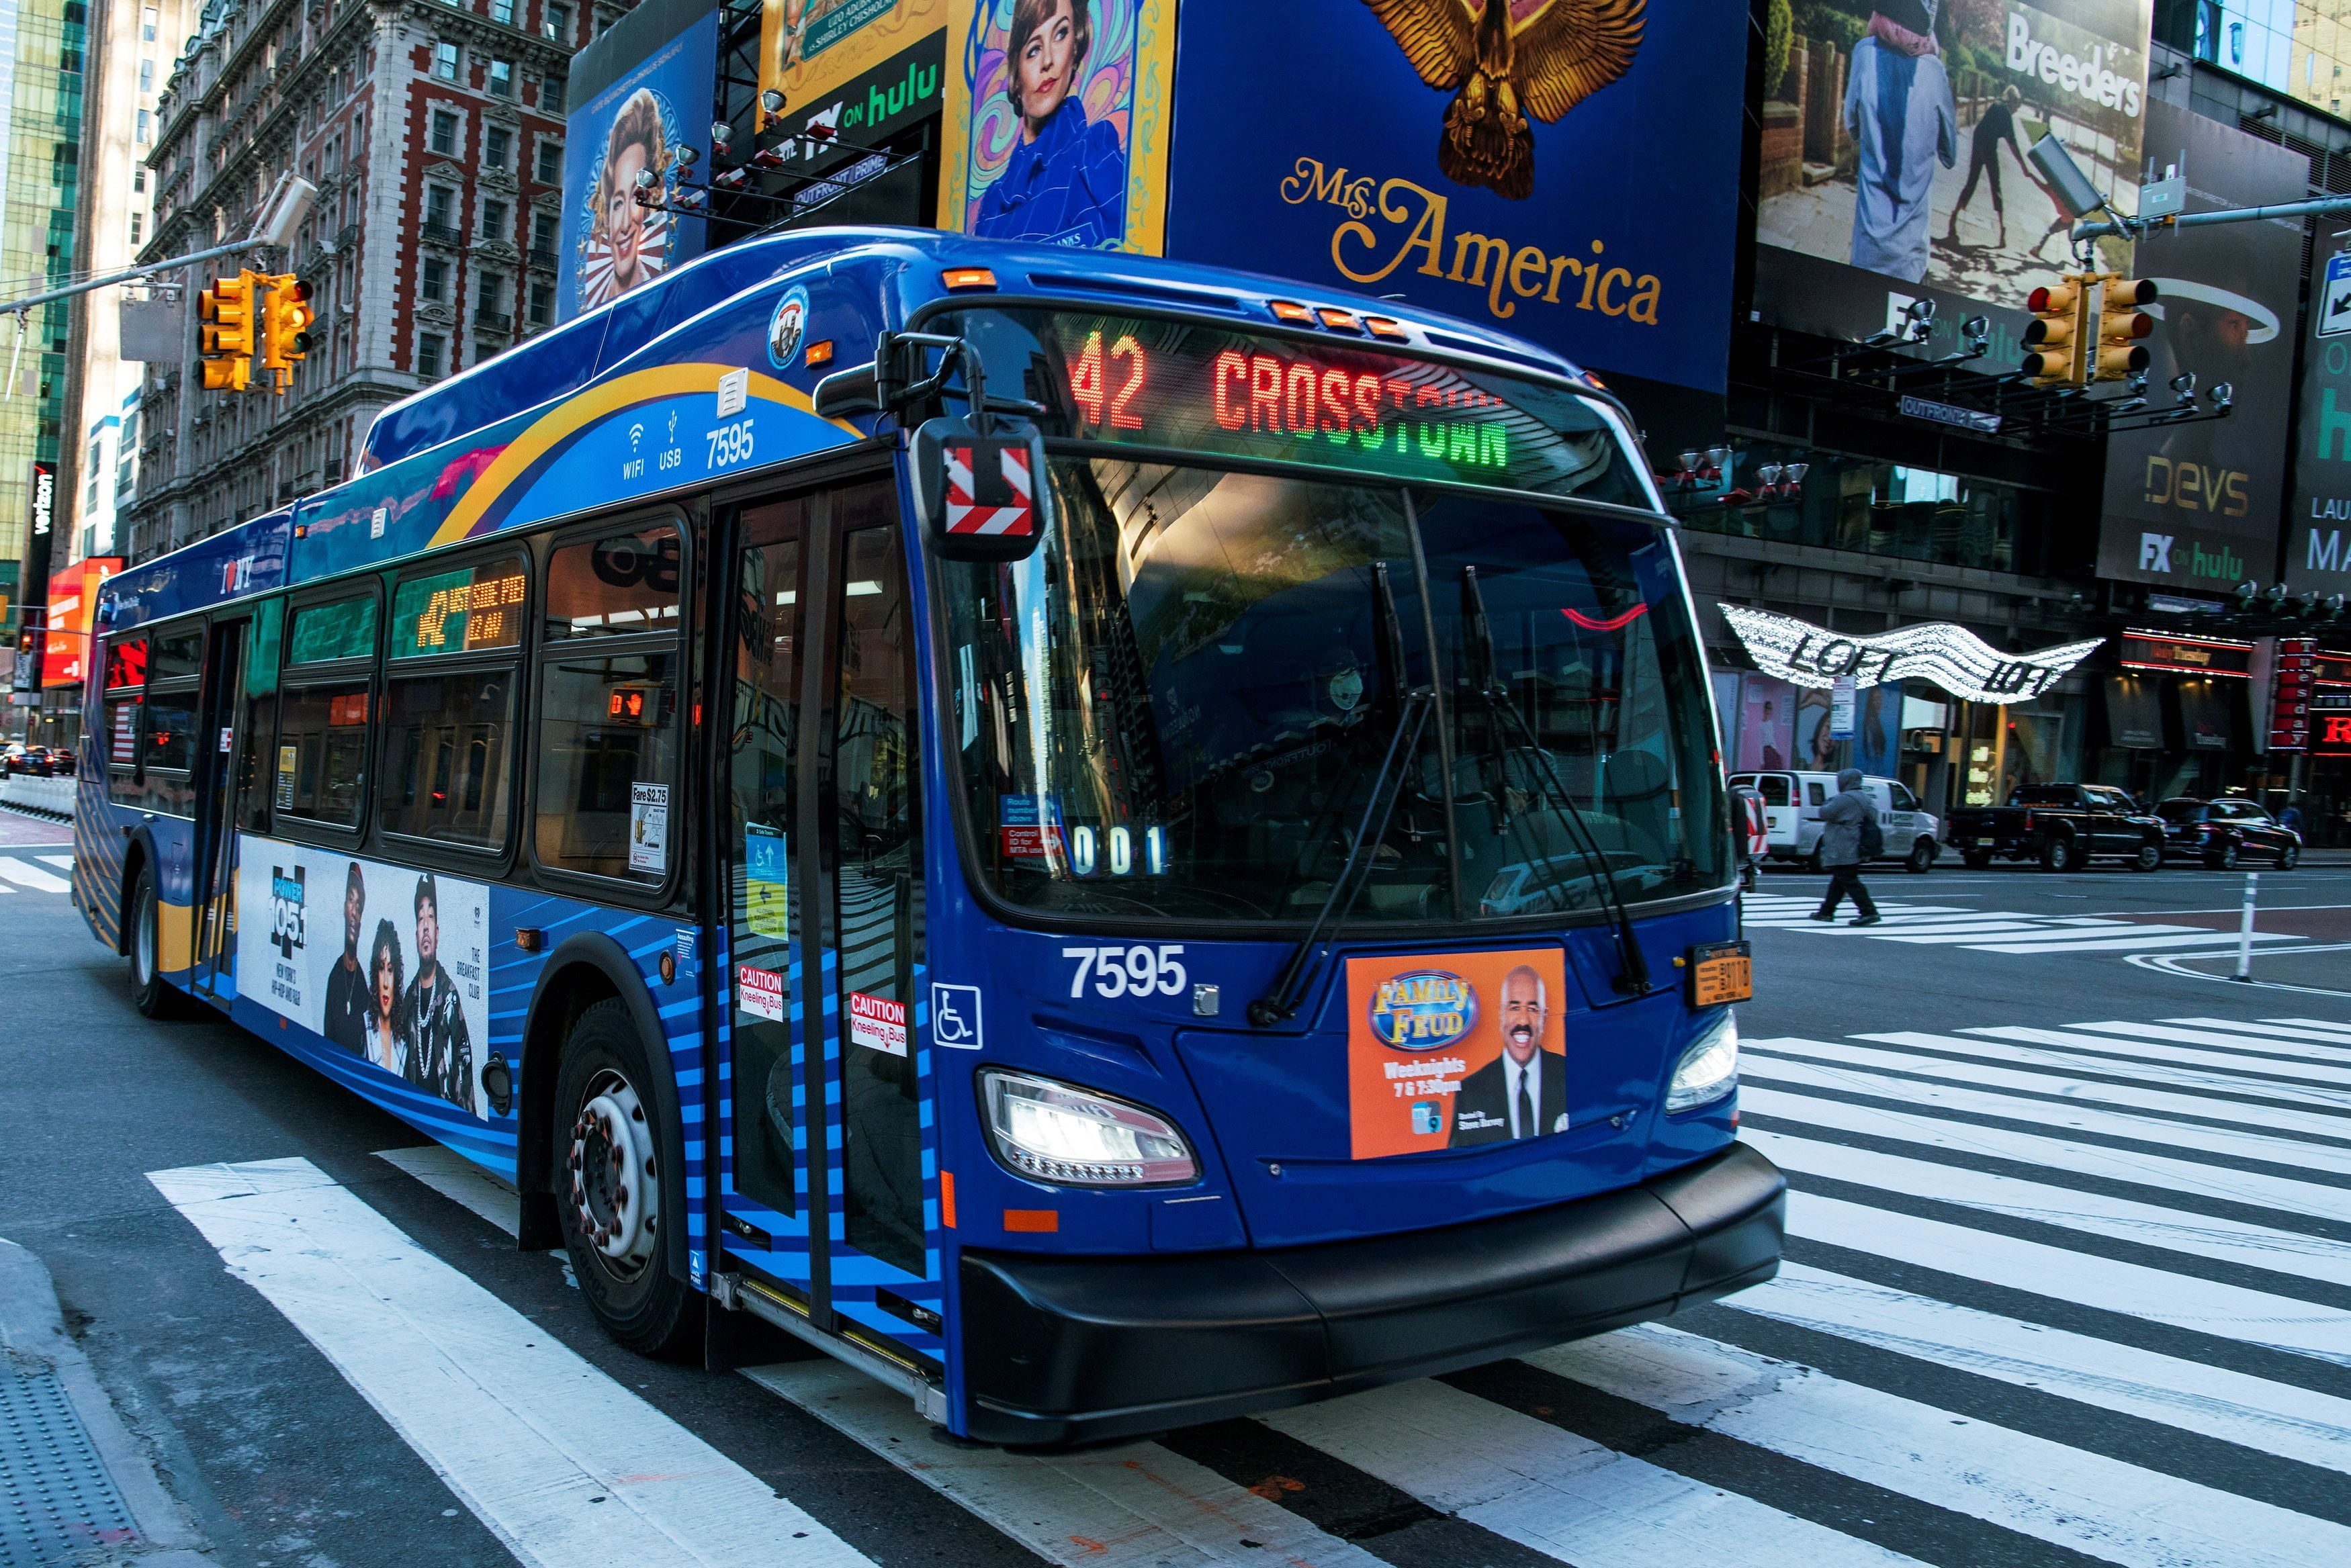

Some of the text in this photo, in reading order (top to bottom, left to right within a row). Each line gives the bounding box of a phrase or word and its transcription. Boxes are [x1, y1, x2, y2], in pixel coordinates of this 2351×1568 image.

[815, 21, 848, 46] SHIRLEY
[2005, 11, 2141, 118] Breeders
[843, 102, 863, 128] ON
[867, 62, 937, 127] hulu
[854, 156, 885, 180] PRIME
[1050, 232, 1081, 247] ANKS
[1280, 156, 1662, 326] Mrs. America
[1071, 331, 1147, 430] 42
[706, 418, 754, 470] 7595
[623, 458, 644, 480] WIFI
[659, 448, 681, 471] USB
[33, 474, 53, 535] verizon
[2139, 532, 2175, 573] FX
[2192, 541, 2244, 582] hulu
[1789, 633, 1908, 683] LOFT
[2290, 641, 2315, 745] Tuesday
[633, 786, 666, 804] Fare $2.75
[1008, 829, 1038, 838] Control
[1009, 838, 1033, 846] ID for
[1009, 846, 1028, 854] MTA
[273, 877, 304, 903] POWER
[269, 896, 308, 946] 105.1
[677, 933, 695, 944] Assaulting
[472, 947, 480, 964] THE
[457, 961, 480, 982] BREAKFAST
[740, 967, 782, 993] CAUTION
[1062, 945, 1188, 999] 7595
[468, 983, 480, 1000] CLUB
[740, 988, 783, 1011] Kneeling Bus
[851, 993, 905, 1023] CAUTION
[852, 1017, 906, 1045] Kneeling Bus
[1390, 1008, 1464, 1044] FEUD
[1383, 1057, 1467, 1080] Weeknights
[1393, 1082, 1404, 1098] 7
